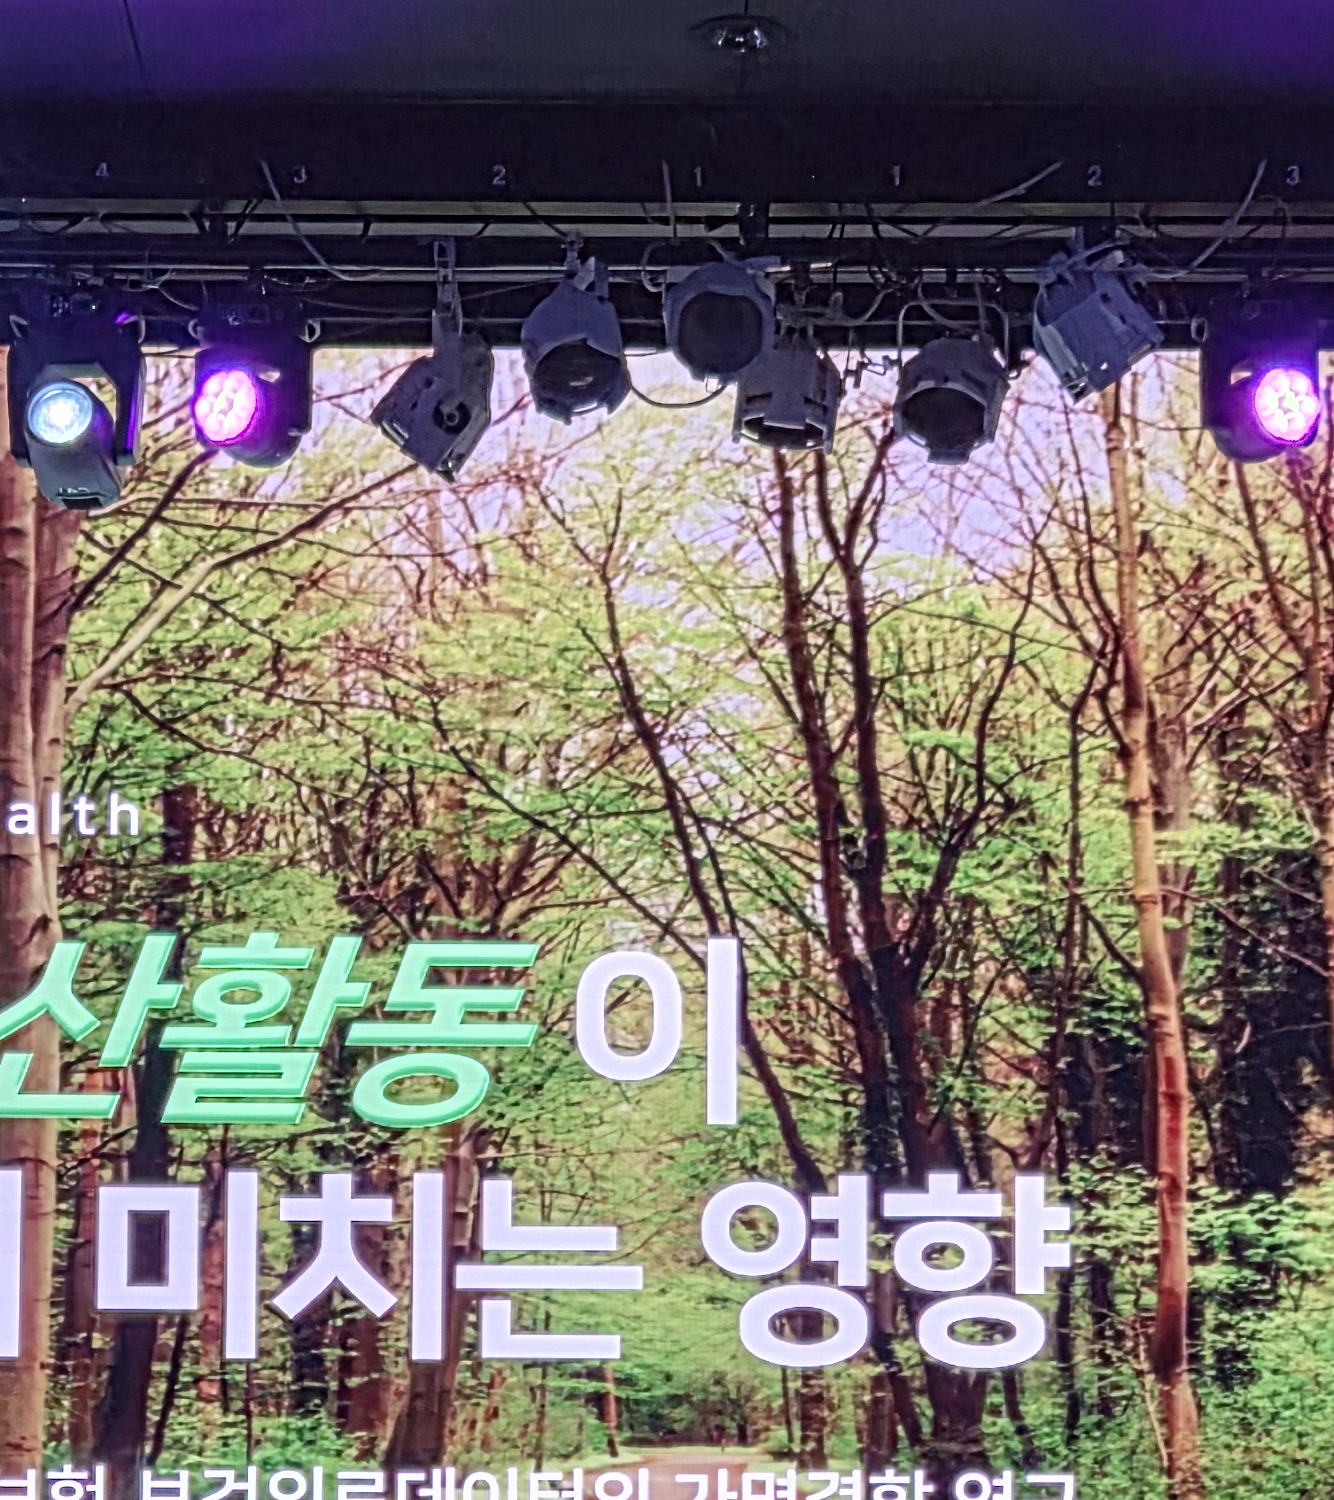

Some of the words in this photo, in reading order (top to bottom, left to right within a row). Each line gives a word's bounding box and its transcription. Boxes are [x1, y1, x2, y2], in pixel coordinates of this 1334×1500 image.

[492, 164, 506, 186] 2
[693, 166, 703, 187] 1
[891, 165, 902, 187] 1
[1087, 164, 1102, 187] 2
[1286, 165, 1301, 186] 3
[95, 1169, 643, 1362] 미치는
[701, 1170, 1072, 1370] 영향
